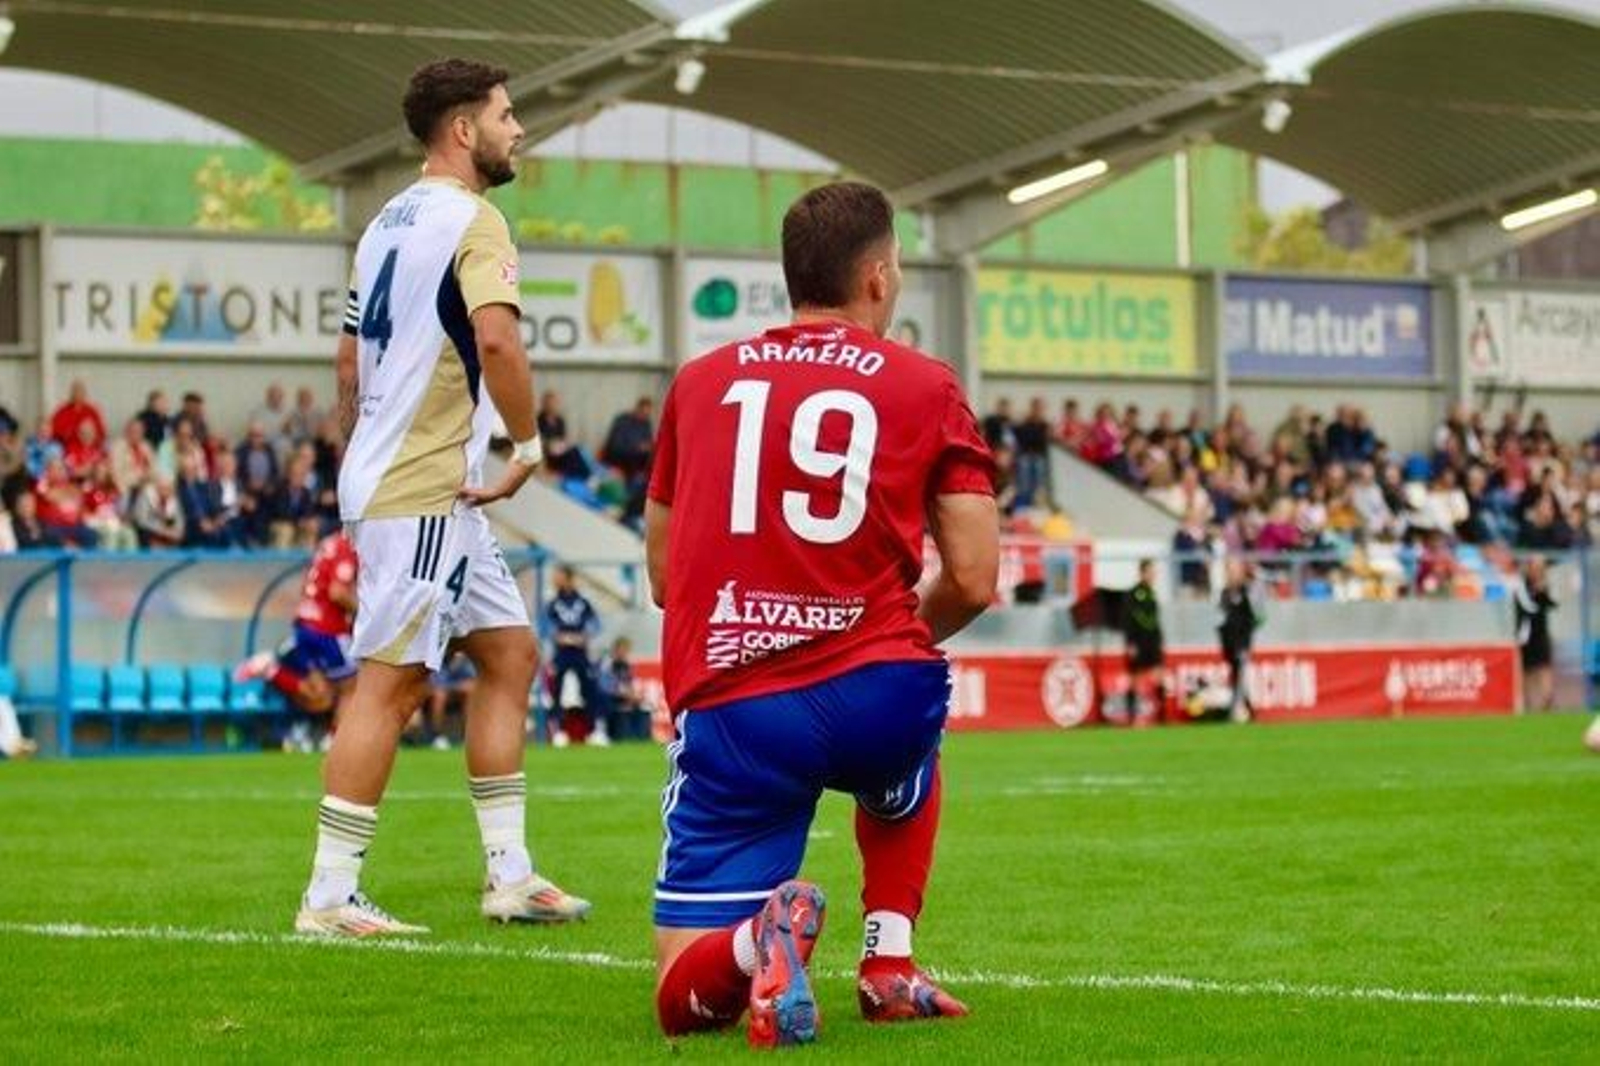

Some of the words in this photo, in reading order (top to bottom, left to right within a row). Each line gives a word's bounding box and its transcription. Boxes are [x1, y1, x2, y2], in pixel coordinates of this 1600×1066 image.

[54, 282, 340, 335] TRISTONE
[360, 247, 398, 366] 4
[1255, 298, 1385, 356] Matud
[720, 379, 879, 543] 19
[446, 555, 469, 604] 4
